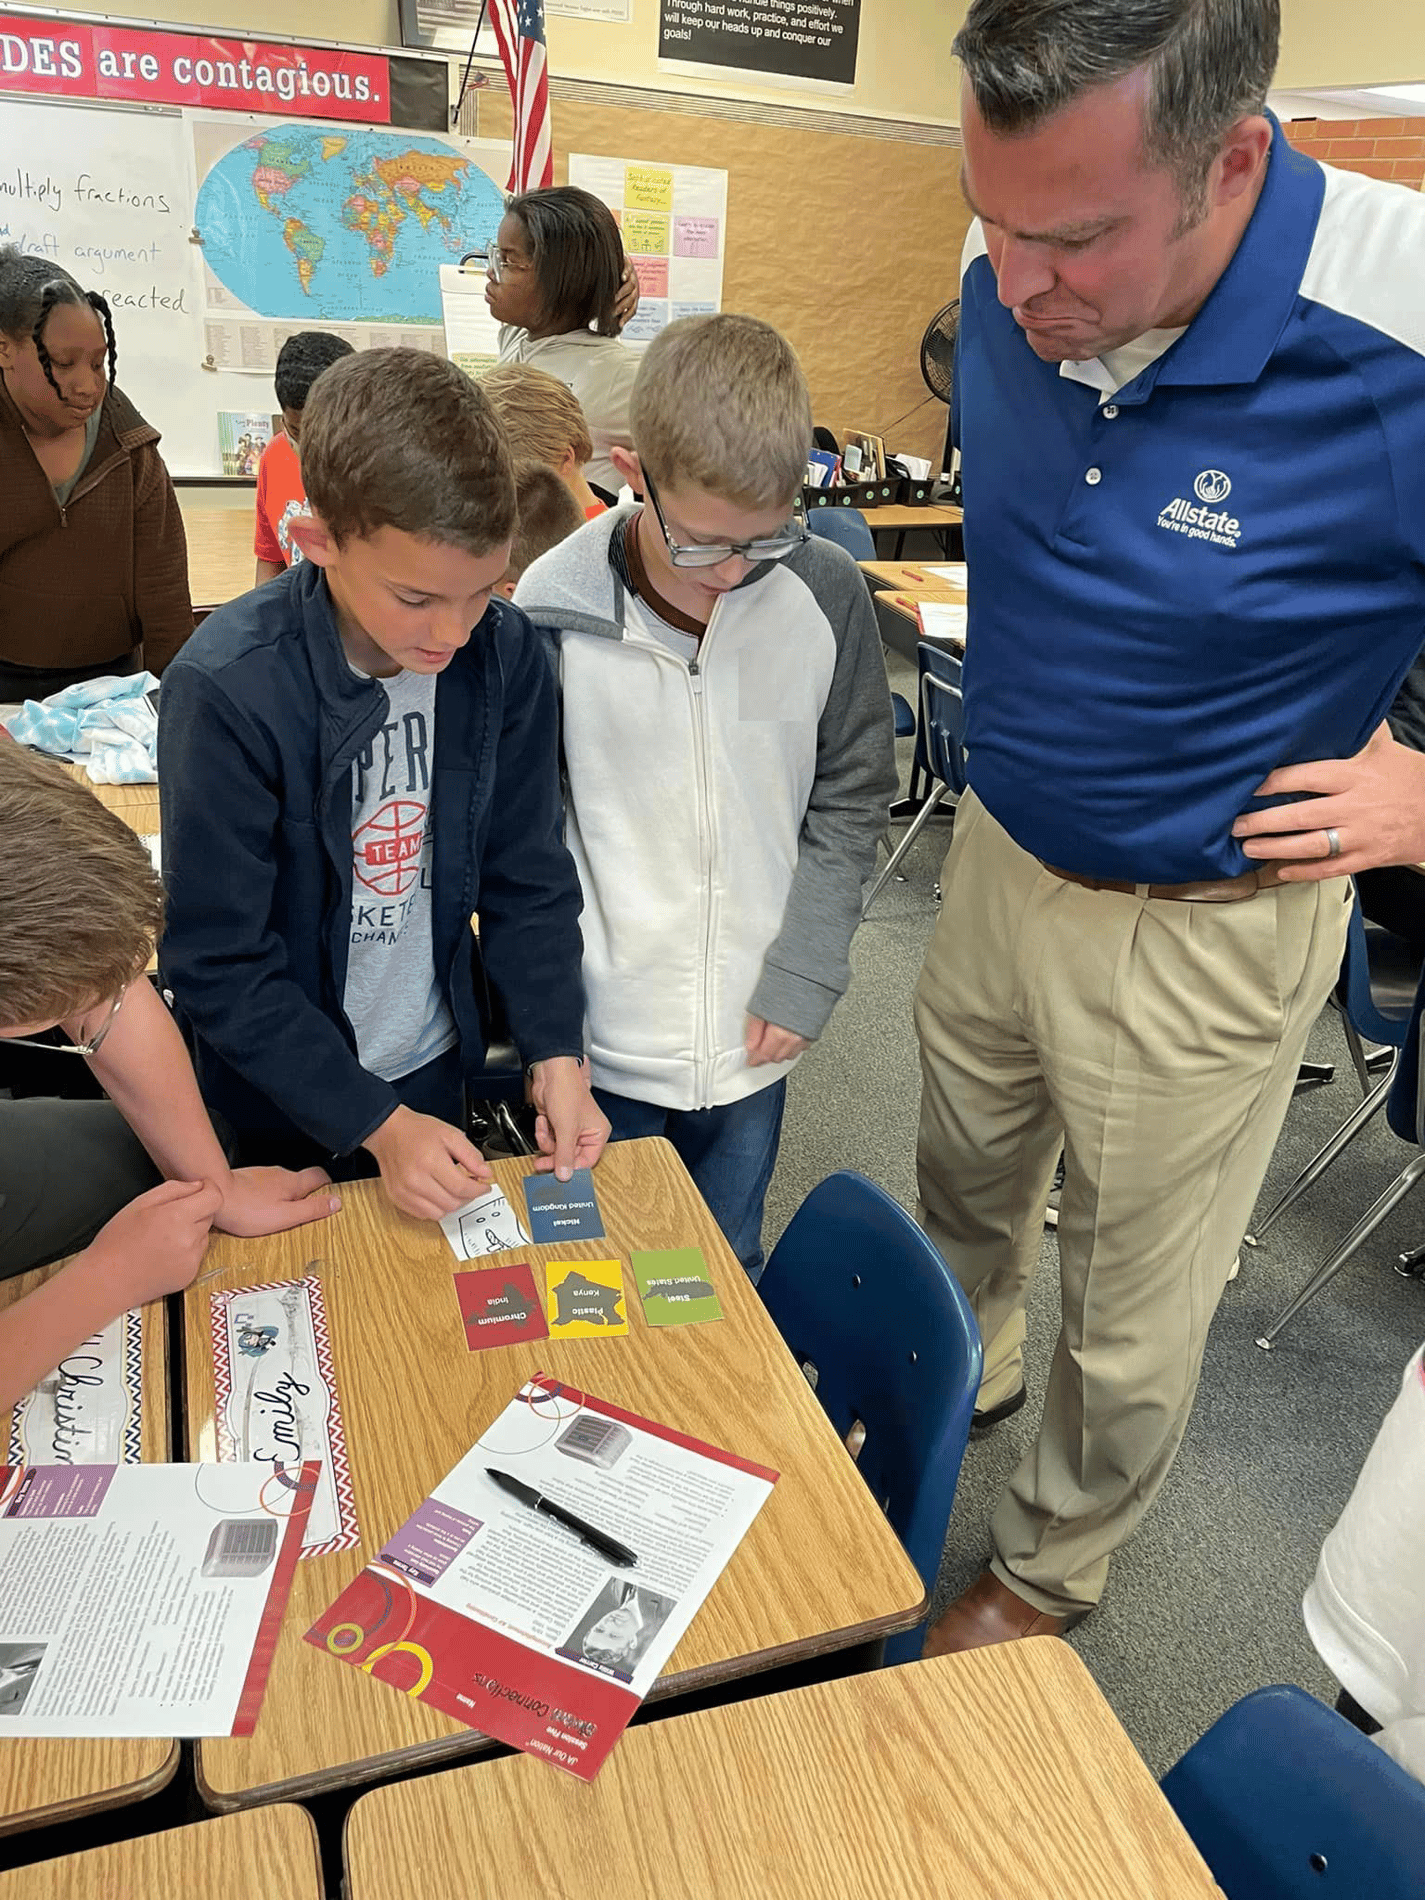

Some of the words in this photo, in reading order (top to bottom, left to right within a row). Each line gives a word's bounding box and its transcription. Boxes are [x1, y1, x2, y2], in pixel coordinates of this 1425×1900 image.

[666, 0, 703, 13] Through
[704, 2, 725, 15] hard
[727, 7, 751, 20] work,
[753, 11, 789, 27] practice,
[790, 17, 807, 28] and
[808, 19, 830, 32] effort
[831, 24, 844, 34] we
[770, 0, 795, 12] things
[797, 4, 838, 20] positively.
[663, 28, 692, 40] goals!
[664, 12, 680, 23] will
[681, 13, 703, 29] keep
[705, 19, 721, 29] our
[722, 20, 749, 34] heads
[751, 26, 763, 38] up
[764, 28, 781, 39] and
[782, 31, 816, 44] conquer
[817, 37, 831, 46] our
[99, 49, 159, 81] are
[172, 56, 381, 102] contagious.
[74, 174, 171, 214] fractions
[14, 233, 60, 257] draft
[74, 241, 162, 275] argument
[1159, 497, 1240, 535] Allstate
[1157, 515, 1181, 532] You're
[1180, 522, 1189, 534] in
[1187, 527, 1211, 540] good
[371, 837, 421, 862] TEAM
[532, 1203, 568, 1211] Kingdom
[568, 1201, 595, 1210] United
[552, 1218, 580, 1227] Nickel
[646, 1278, 673, 1286] States
[674, 1275, 701, 1284] United
[572, 1289, 600, 1297] Kenya
[667, 1293, 691, 1303] Steel
[486, 1296, 509, 1305] India
[477, 1311, 527, 1325] Chromium
[571, 1307, 604, 1315] Plastic
[253, 1371, 310, 1462] Emily
[455, 1692, 477, 1709] Name
[472, 1672, 550, 1718] Connections
[545, 1725, 562, 1738] Five
[560, 1732, 588, 1751] Session
[552, 1748, 568, 1760] Our
[567, 1755, 579, 1766] JA
